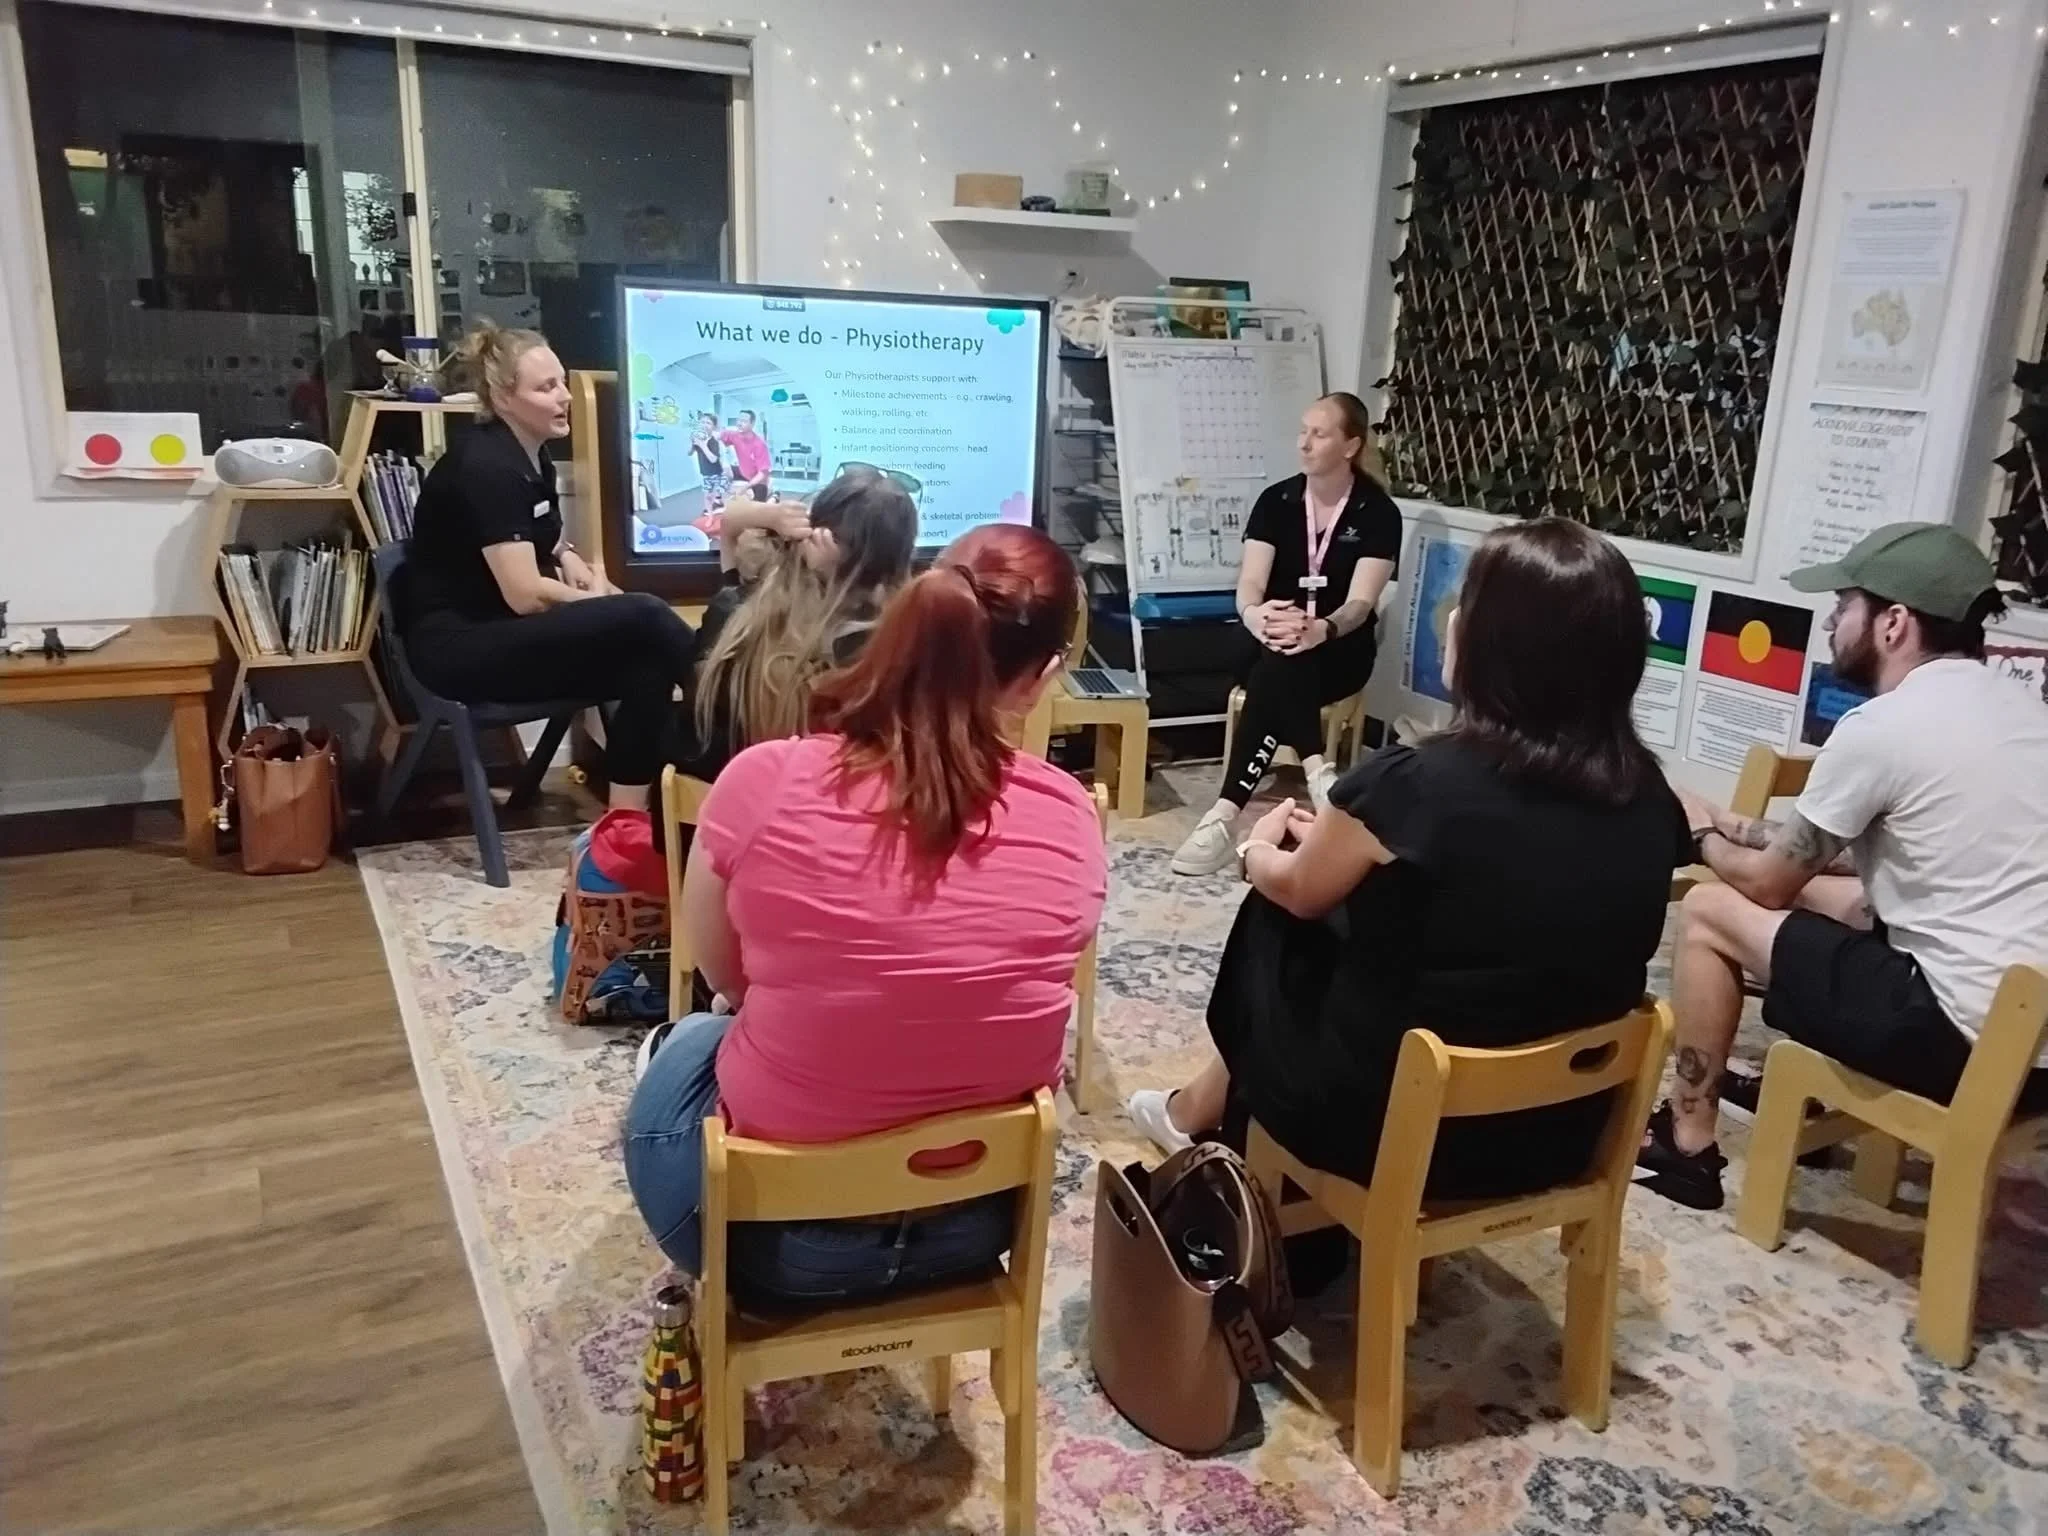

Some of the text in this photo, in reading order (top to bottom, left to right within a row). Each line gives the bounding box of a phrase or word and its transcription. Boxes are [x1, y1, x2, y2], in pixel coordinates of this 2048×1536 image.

[696, 320, 753, 342] What
[761, 328, 790, 344] we
[798, 326, 823, 345] do
[846, 328, 984, 355] Physiotherapy
[825, 370, 842, 380] Our
[845, 370, 919, 382] Physiotherapists
[921, 373, 956, 384] support
[841, 389, 886, 400] Milestone
[887, 391, 948, 401] achievements
[975, 393, 1014, 404] crawling,
[841, 425, 953, 436] Balance and coordination
[841, 443, 868, 453] Infant
[870, 444, 920, 456] positioning
[921, 445, 960, 454] concerns
[967, 444, 989, 453] head
[914, 461, 946, 472] feeding
[930, 512, 963, 521] skeletal
[1999, 656, 2034, 682] One
[1238, 734, 1278, 791] LSKD
